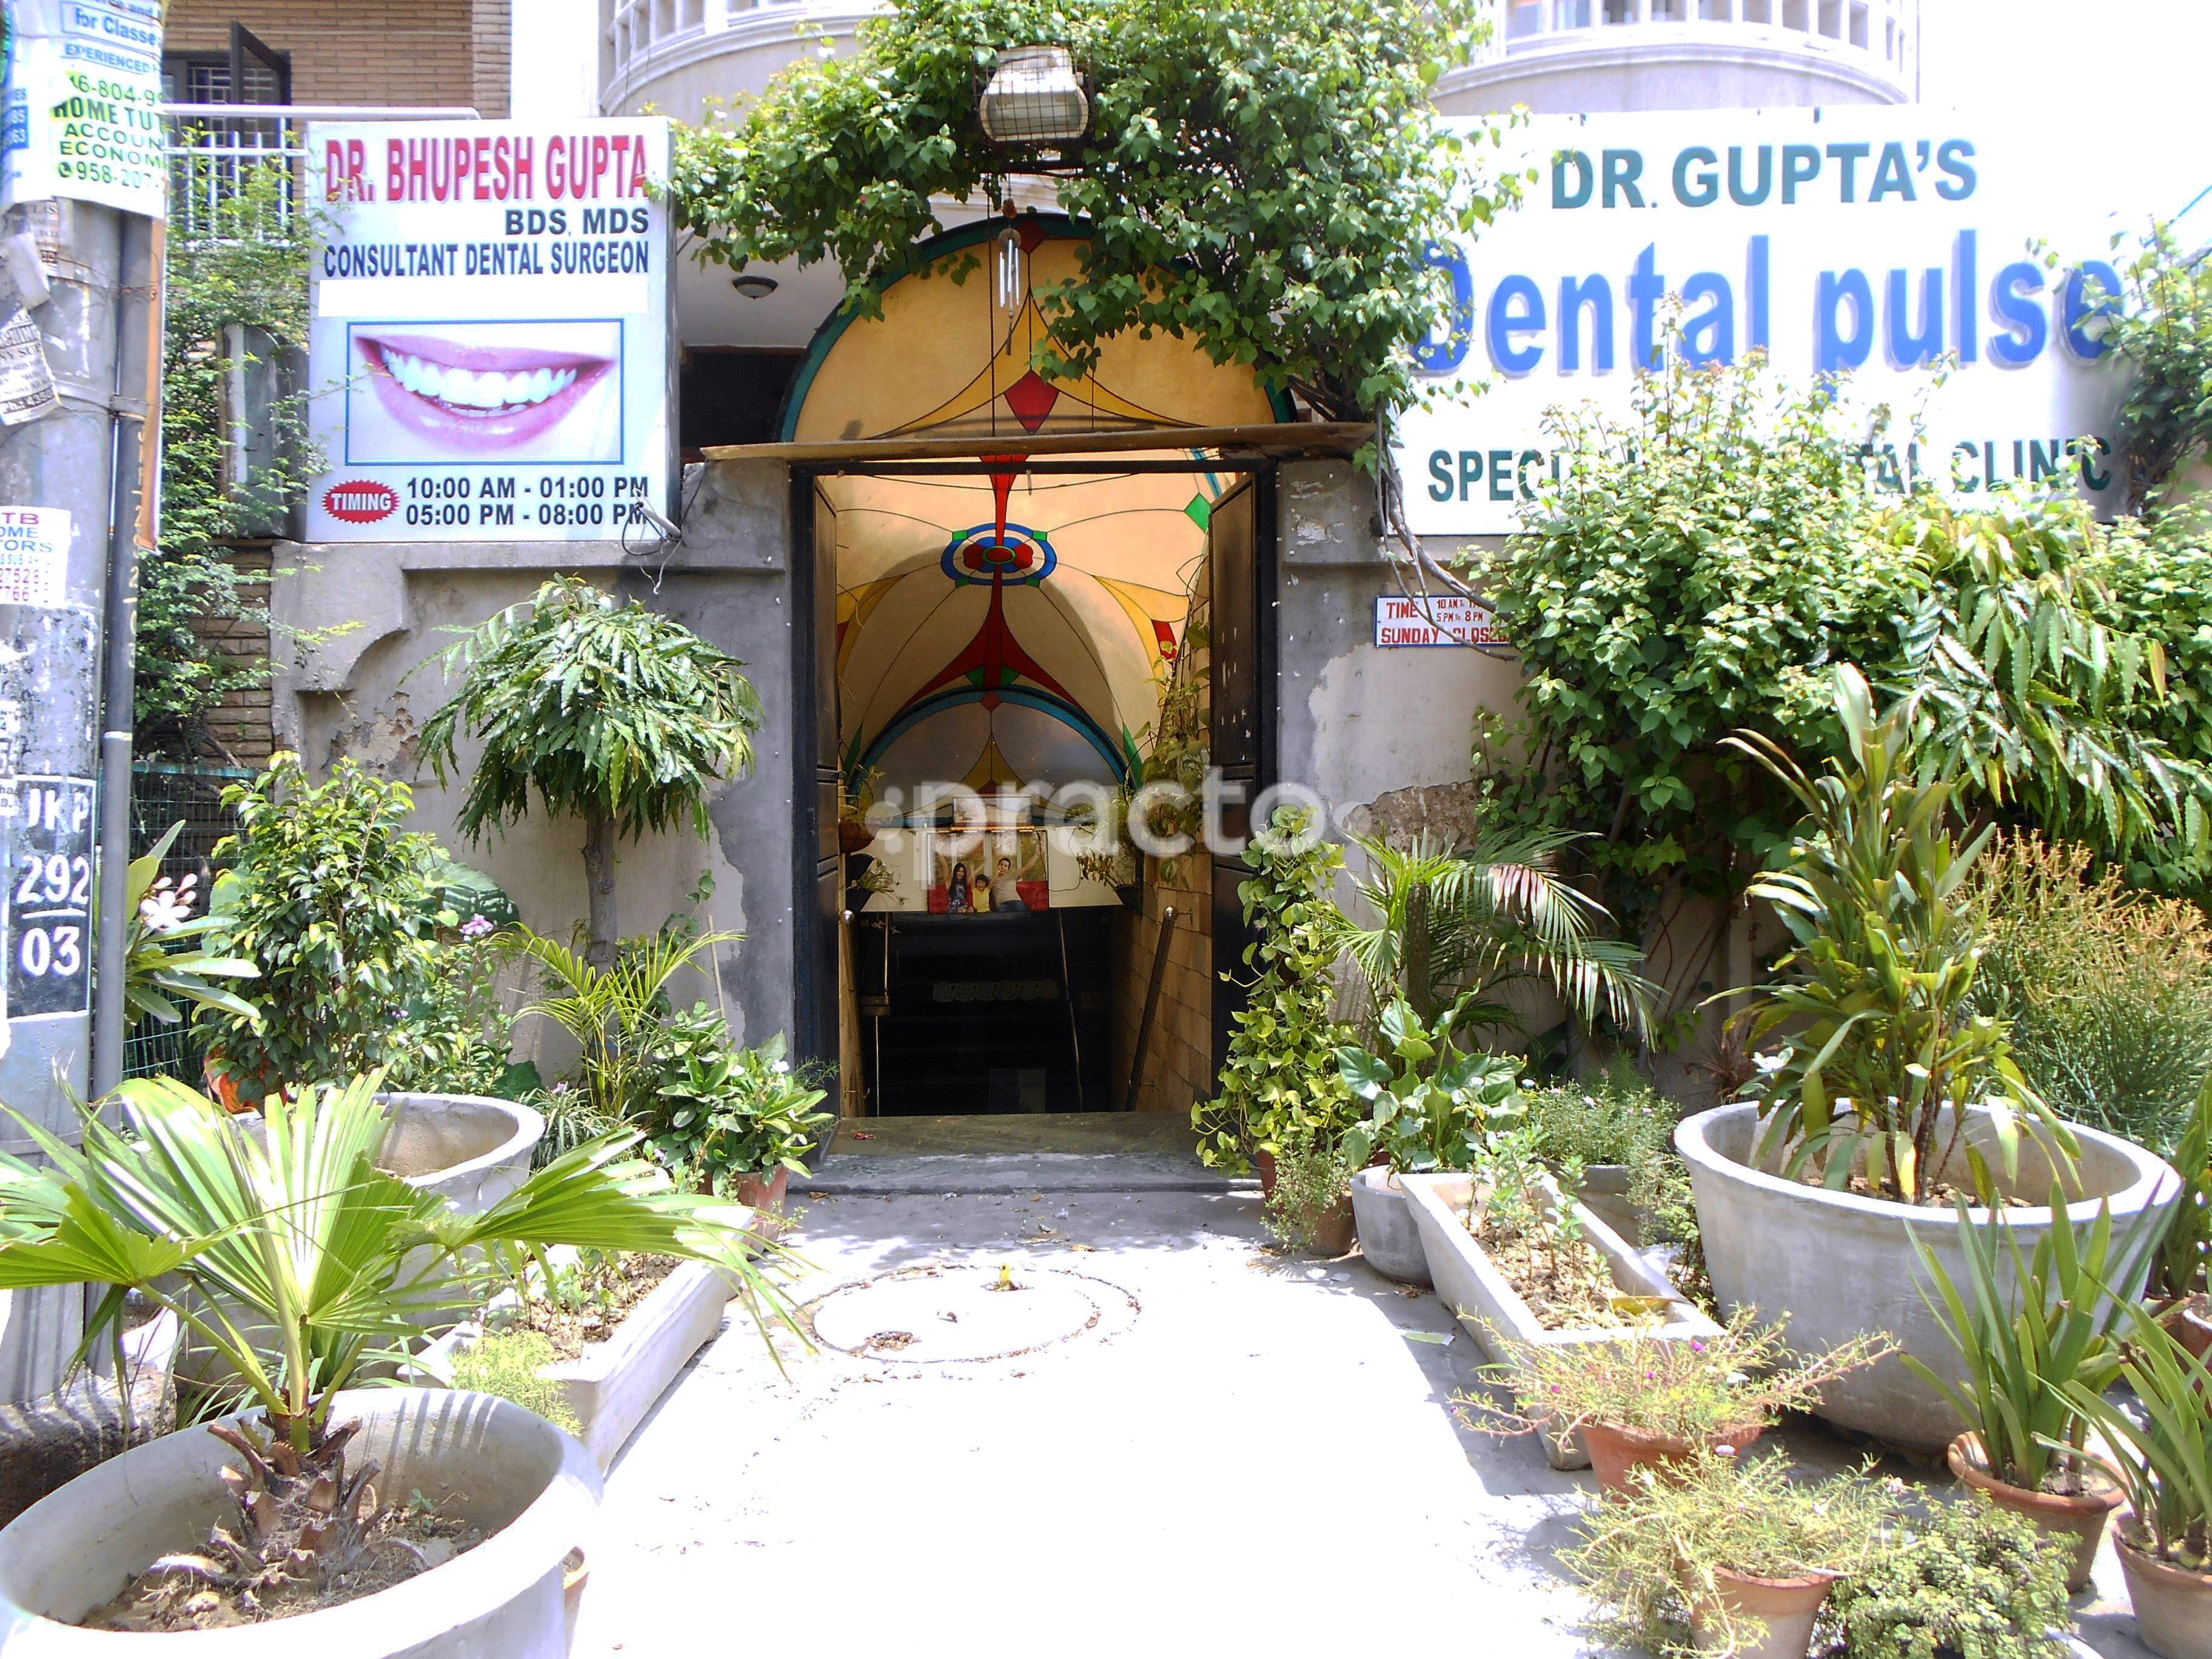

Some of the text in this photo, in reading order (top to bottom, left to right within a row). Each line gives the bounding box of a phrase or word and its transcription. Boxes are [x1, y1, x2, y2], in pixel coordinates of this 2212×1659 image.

[103, 16, 161, 46] Classe
[64, 43, 150, 73] EXPERIENCED
[326, 135, 649, 203] DR. BHUPESH GUPTA
[1551, 138, 1978, 210] DR. GUPTA'S
[582, 207, 649, 235] MDS
[324, 241, 648, 277] CONSULTANT DENTAL SURGEON
[1408, 228, 2126, 403] Dental pulse
[1952, 437, 2112, 493] CLINC
[331, 493, 392, 511] TIMING
[407, 477, 471, 498] 10:00
[479, 476, 515, 498] AM
[540, 477, 605, 498] 01:00
[614, 476, 648, 498] PM
[406, 503, 470, 525] 05:00
[479, 503, 514, 525] PM
[538, 503, 603, 525] 08:00
[612, 503, 648, 525] PM
[0, 539, 53, 553] ORS
[1386, 602, 1419, 619] TIME
[1436, 598, 1446, 609] 10
[1448, 598, 1458, 609] AM
[1436, 612, 1442, 622] 5
[1443, 612, 1453, 622] PM
[1464, 610, 1472, 622] 8
[1473, 611, 1484, 622] PM
[1381, 627, 1439, 644] SUNDAY
[16, 853, 90, 905] 292
[22, 925, 81, 977] 03
